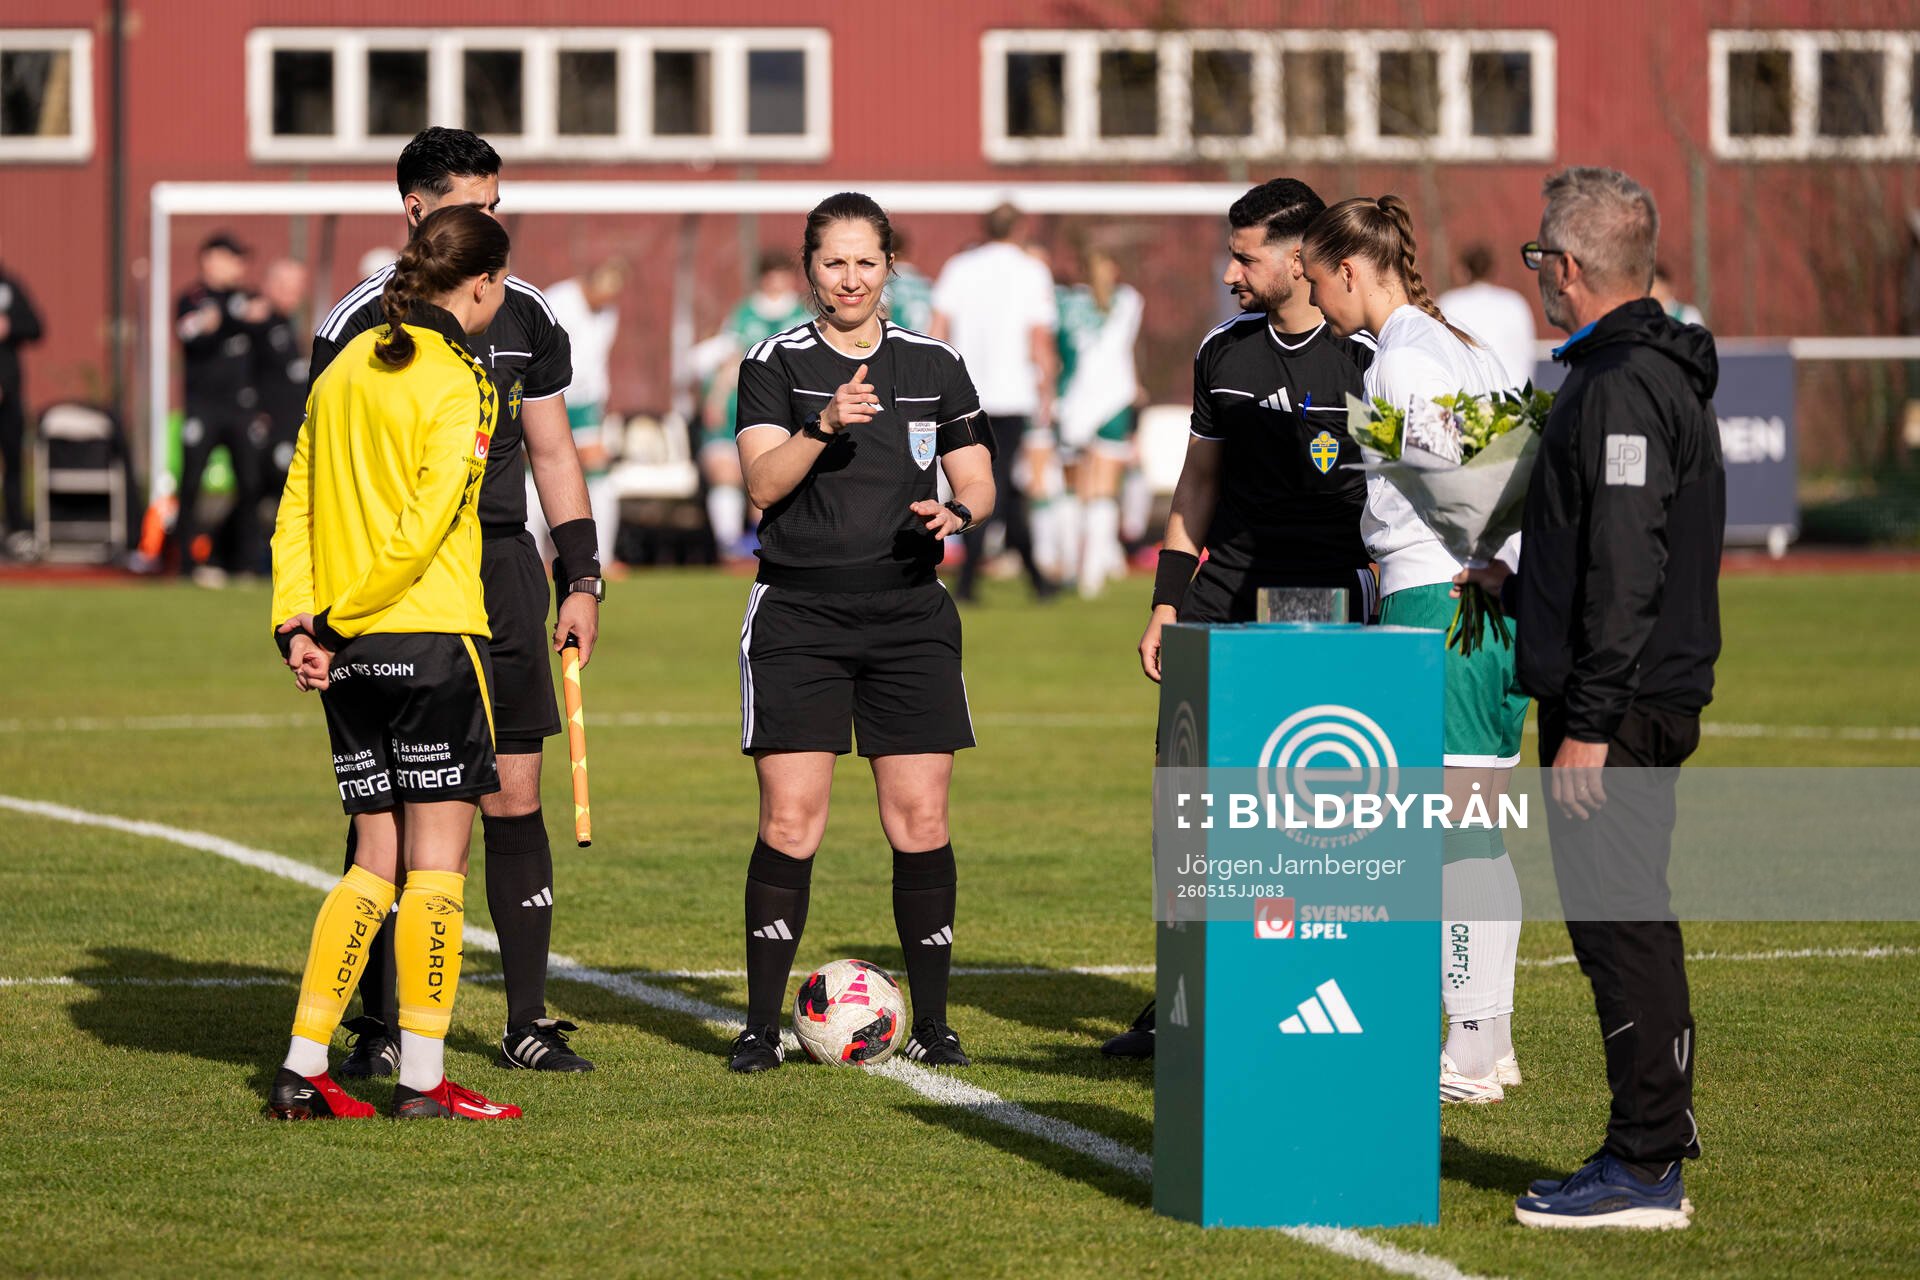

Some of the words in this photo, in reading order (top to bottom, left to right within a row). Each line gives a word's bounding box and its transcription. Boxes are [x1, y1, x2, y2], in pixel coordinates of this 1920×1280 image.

[1718, 416, 1786, 464] EN
[372, 663, 414, 677] SOHN
[411, 742, 450, 753] HÄRADS
[401, 751, 451, 763] FASTIGHETER
[1300, 904, 1390, 923] SVENSKA
[1300, 922, 1348, 939] SPEL
[1450, 923, 1469, 972] CRAFT
